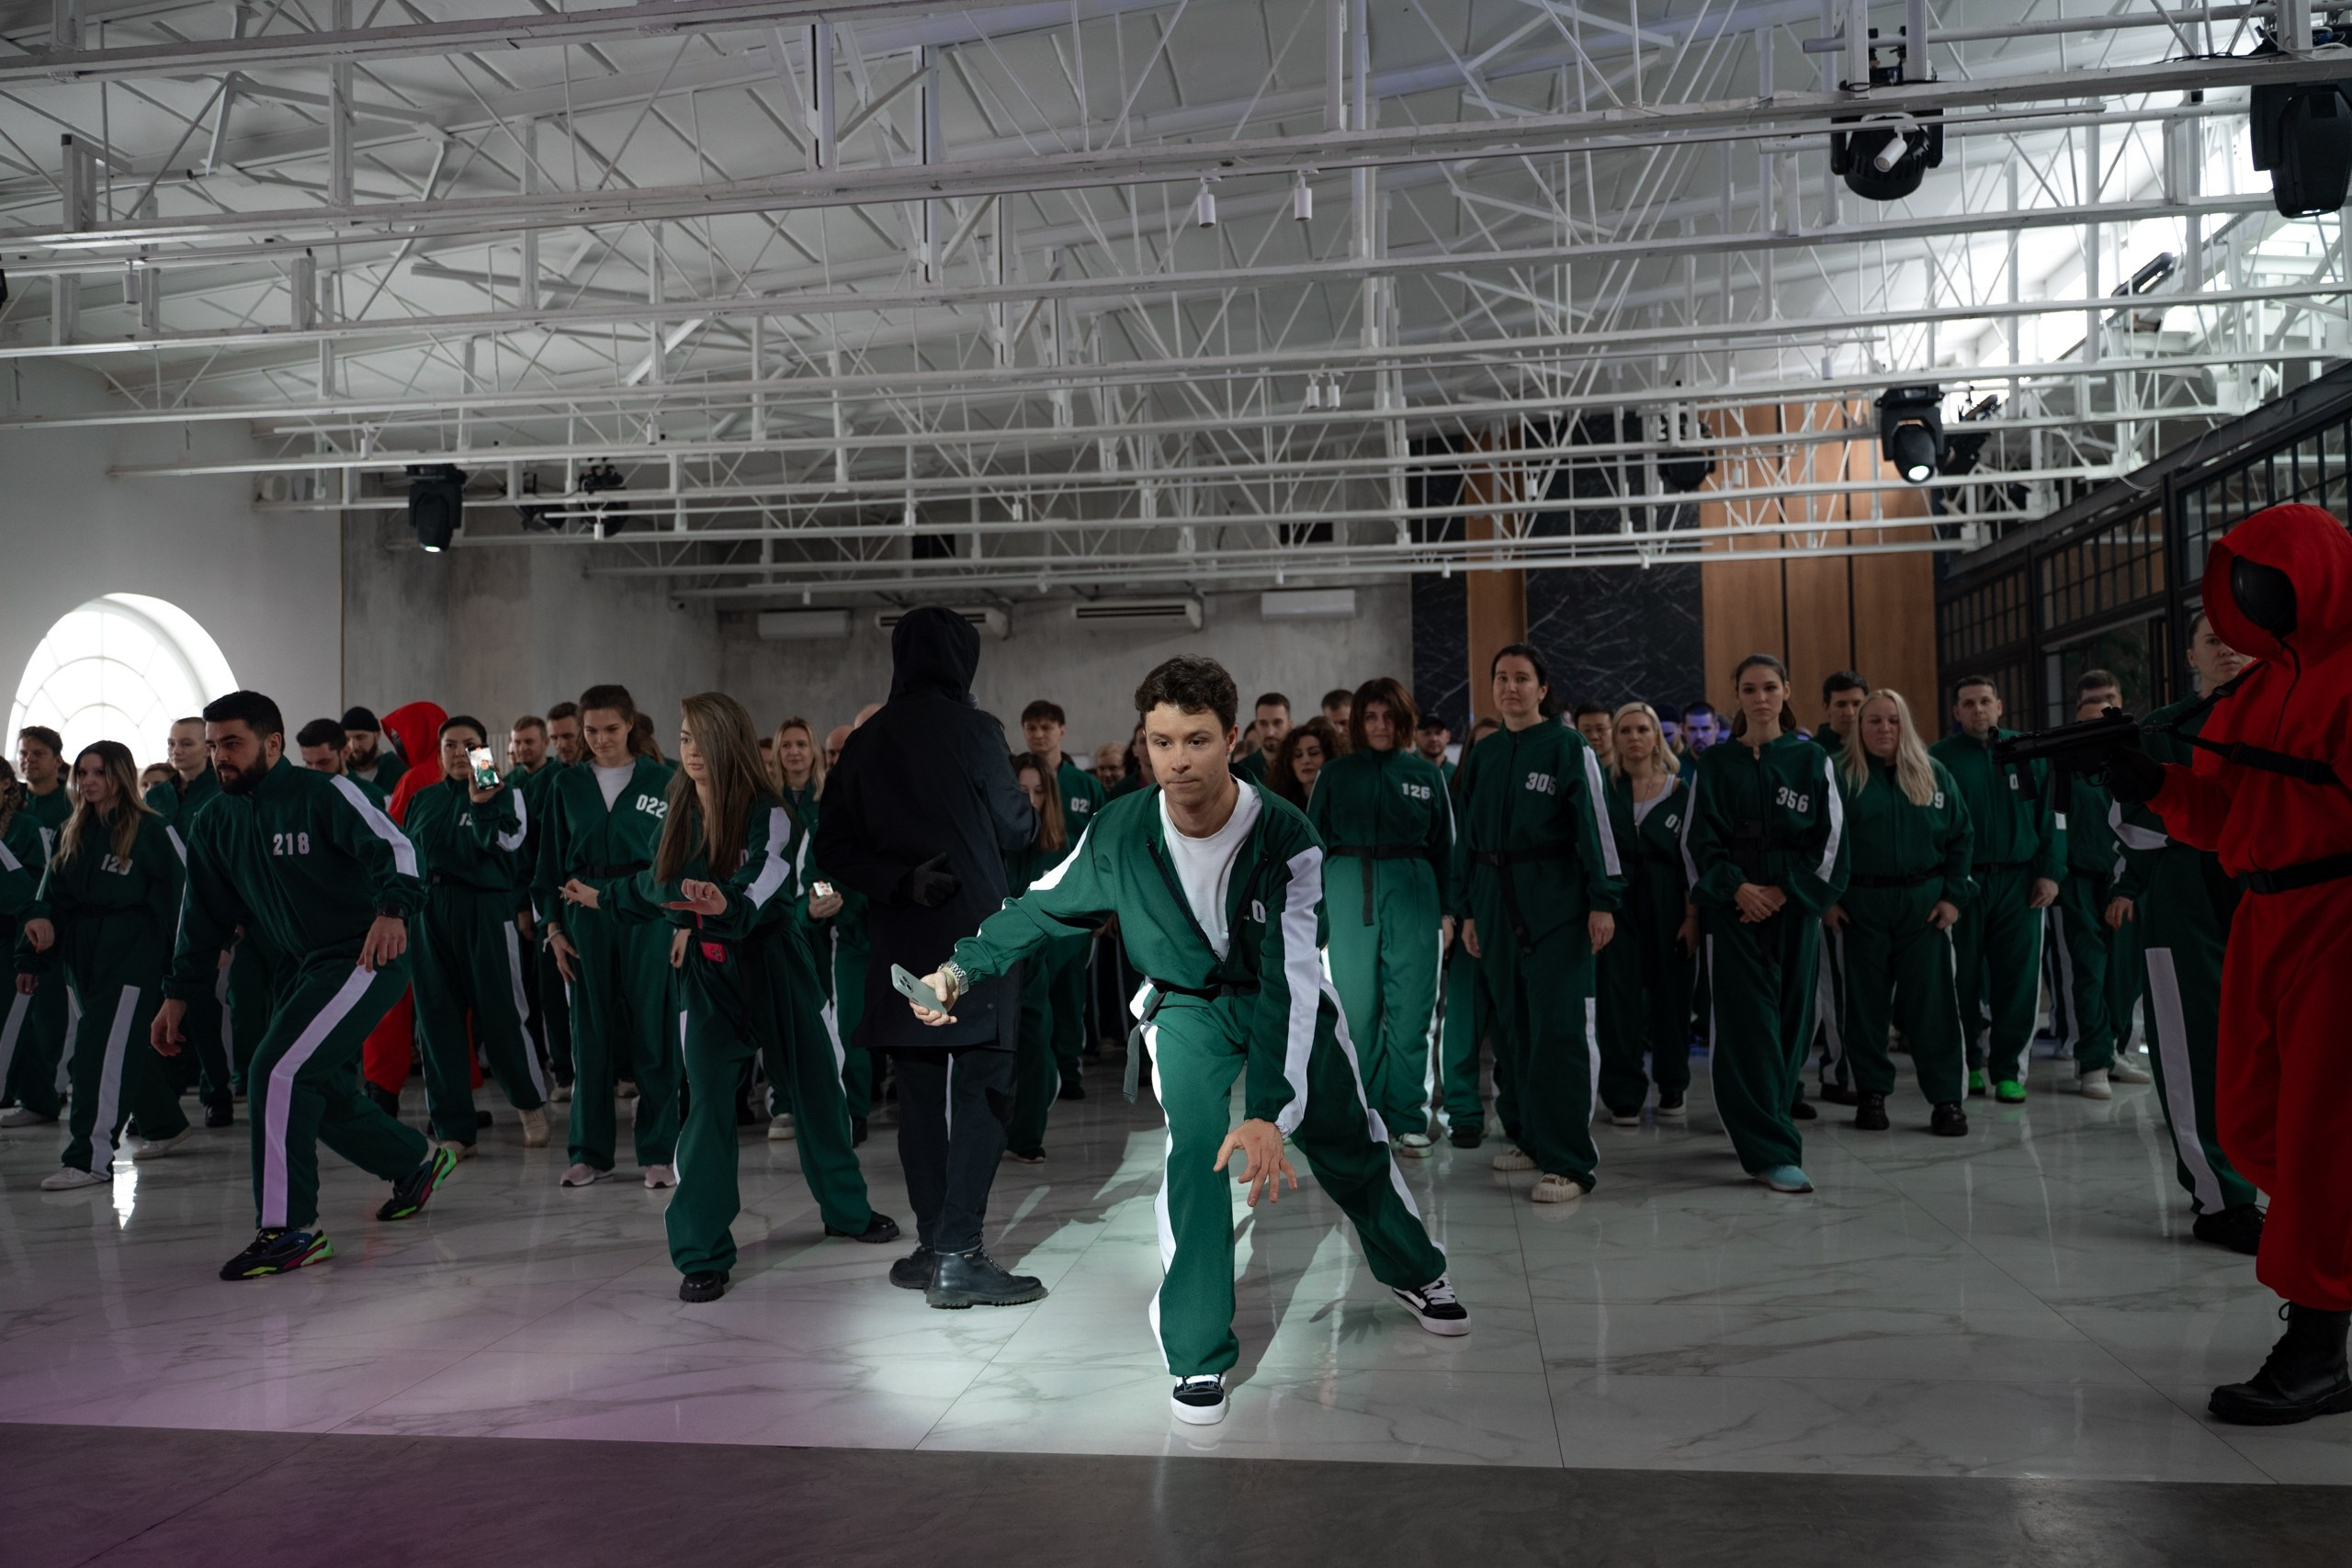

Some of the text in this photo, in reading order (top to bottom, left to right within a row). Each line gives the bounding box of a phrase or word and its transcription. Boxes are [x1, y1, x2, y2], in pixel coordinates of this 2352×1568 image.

[1402, 783, 1431, 800] 126
[1525, 772, 1557, 796] 305
[636, 794, 669, 819] 022
[1070, 796, 1091, 813] 02
[1776, 786, 1810, 813] 356
[273, 831, 311, 856] 218
